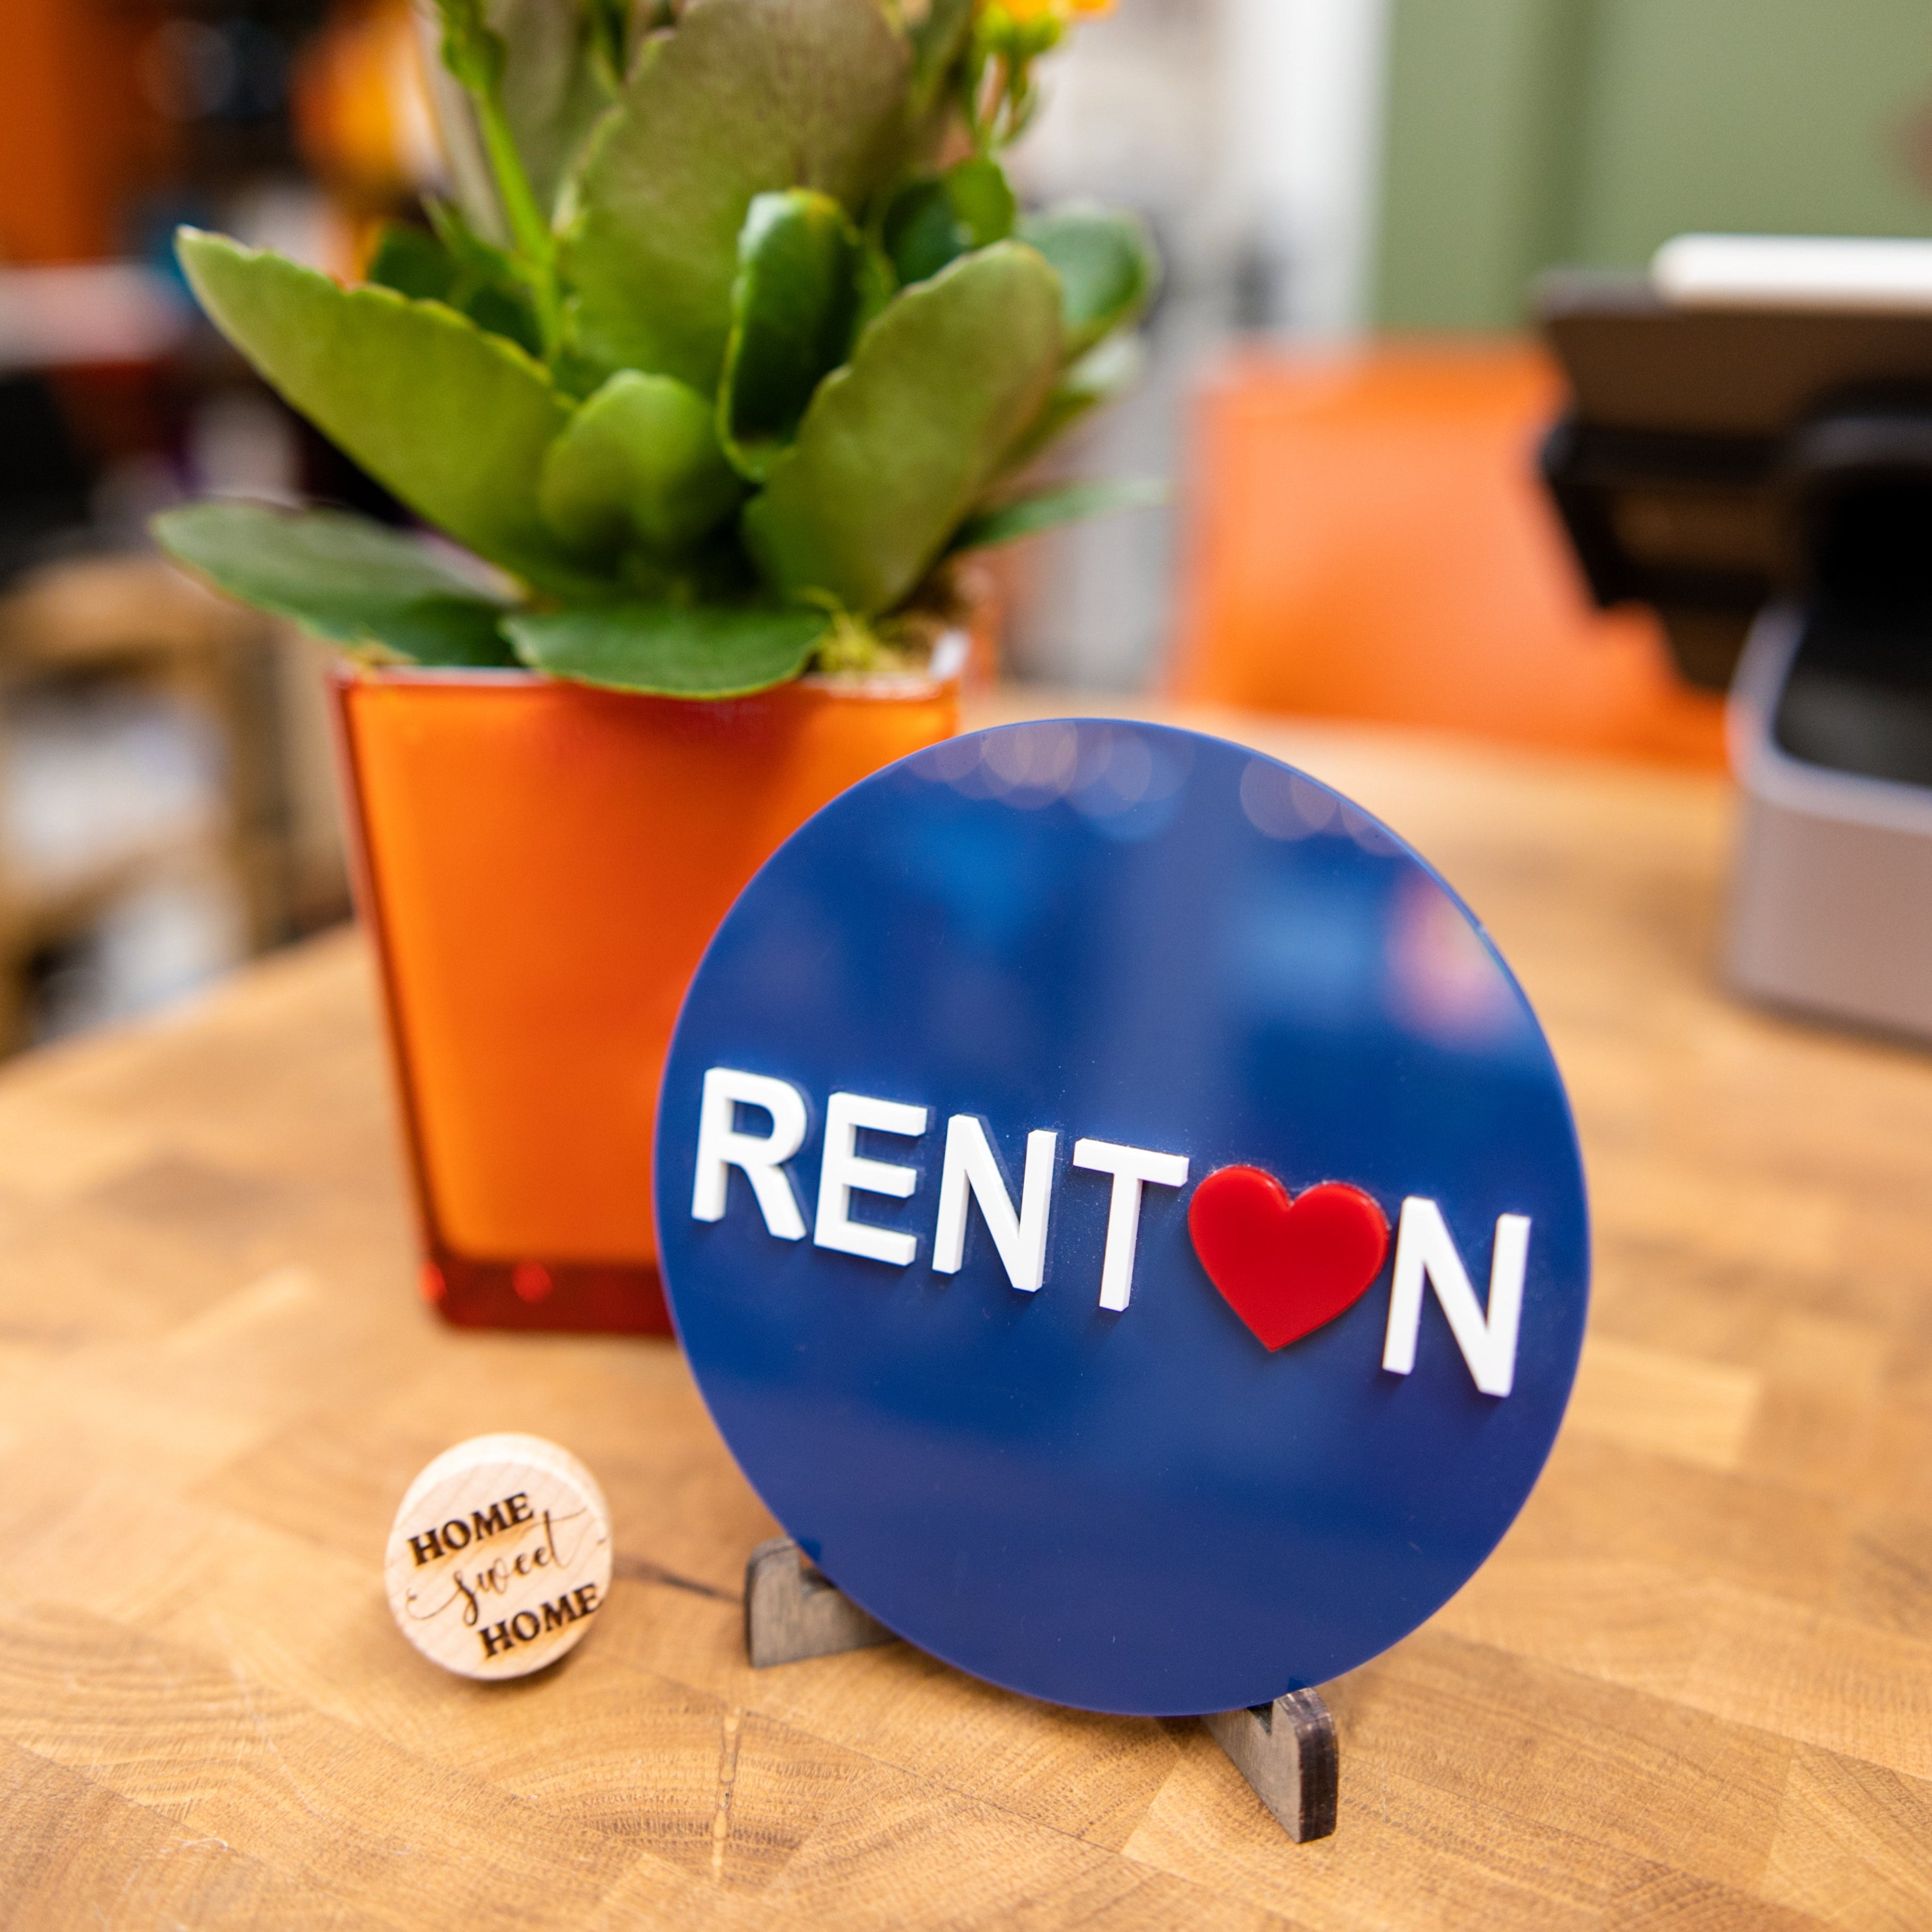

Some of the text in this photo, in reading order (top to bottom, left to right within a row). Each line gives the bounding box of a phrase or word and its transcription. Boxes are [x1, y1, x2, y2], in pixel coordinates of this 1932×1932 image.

[407, 1507, 600, 1626] sweet
[408, 1492, 534, 1566] HOME
[478, 1582, 604, 1657] HOME
